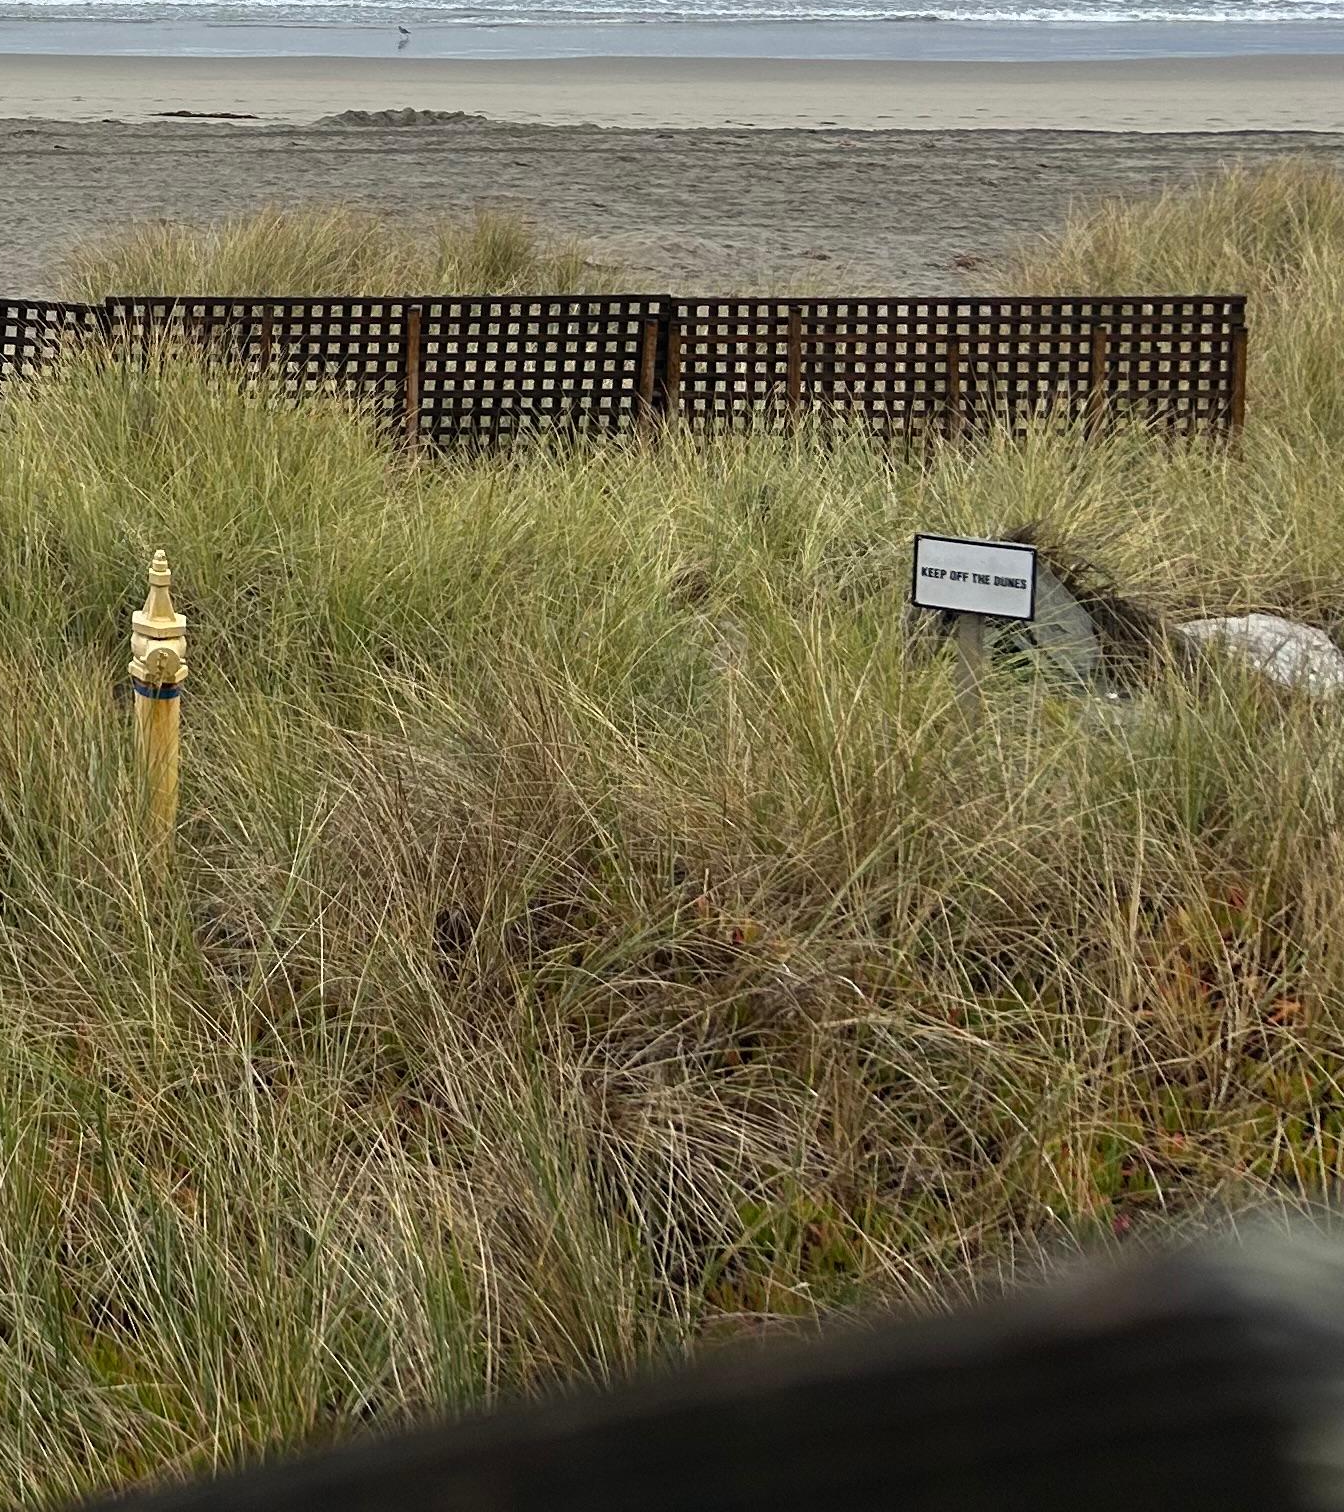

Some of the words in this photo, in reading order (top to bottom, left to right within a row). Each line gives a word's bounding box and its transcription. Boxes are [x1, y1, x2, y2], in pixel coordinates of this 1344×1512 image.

[921, 566, 947, 579] KEEP
[950, 570, 969, 582] OFF
[972, 573, 990, 585] THE
[994, 575, 1027, 590] DUNES
